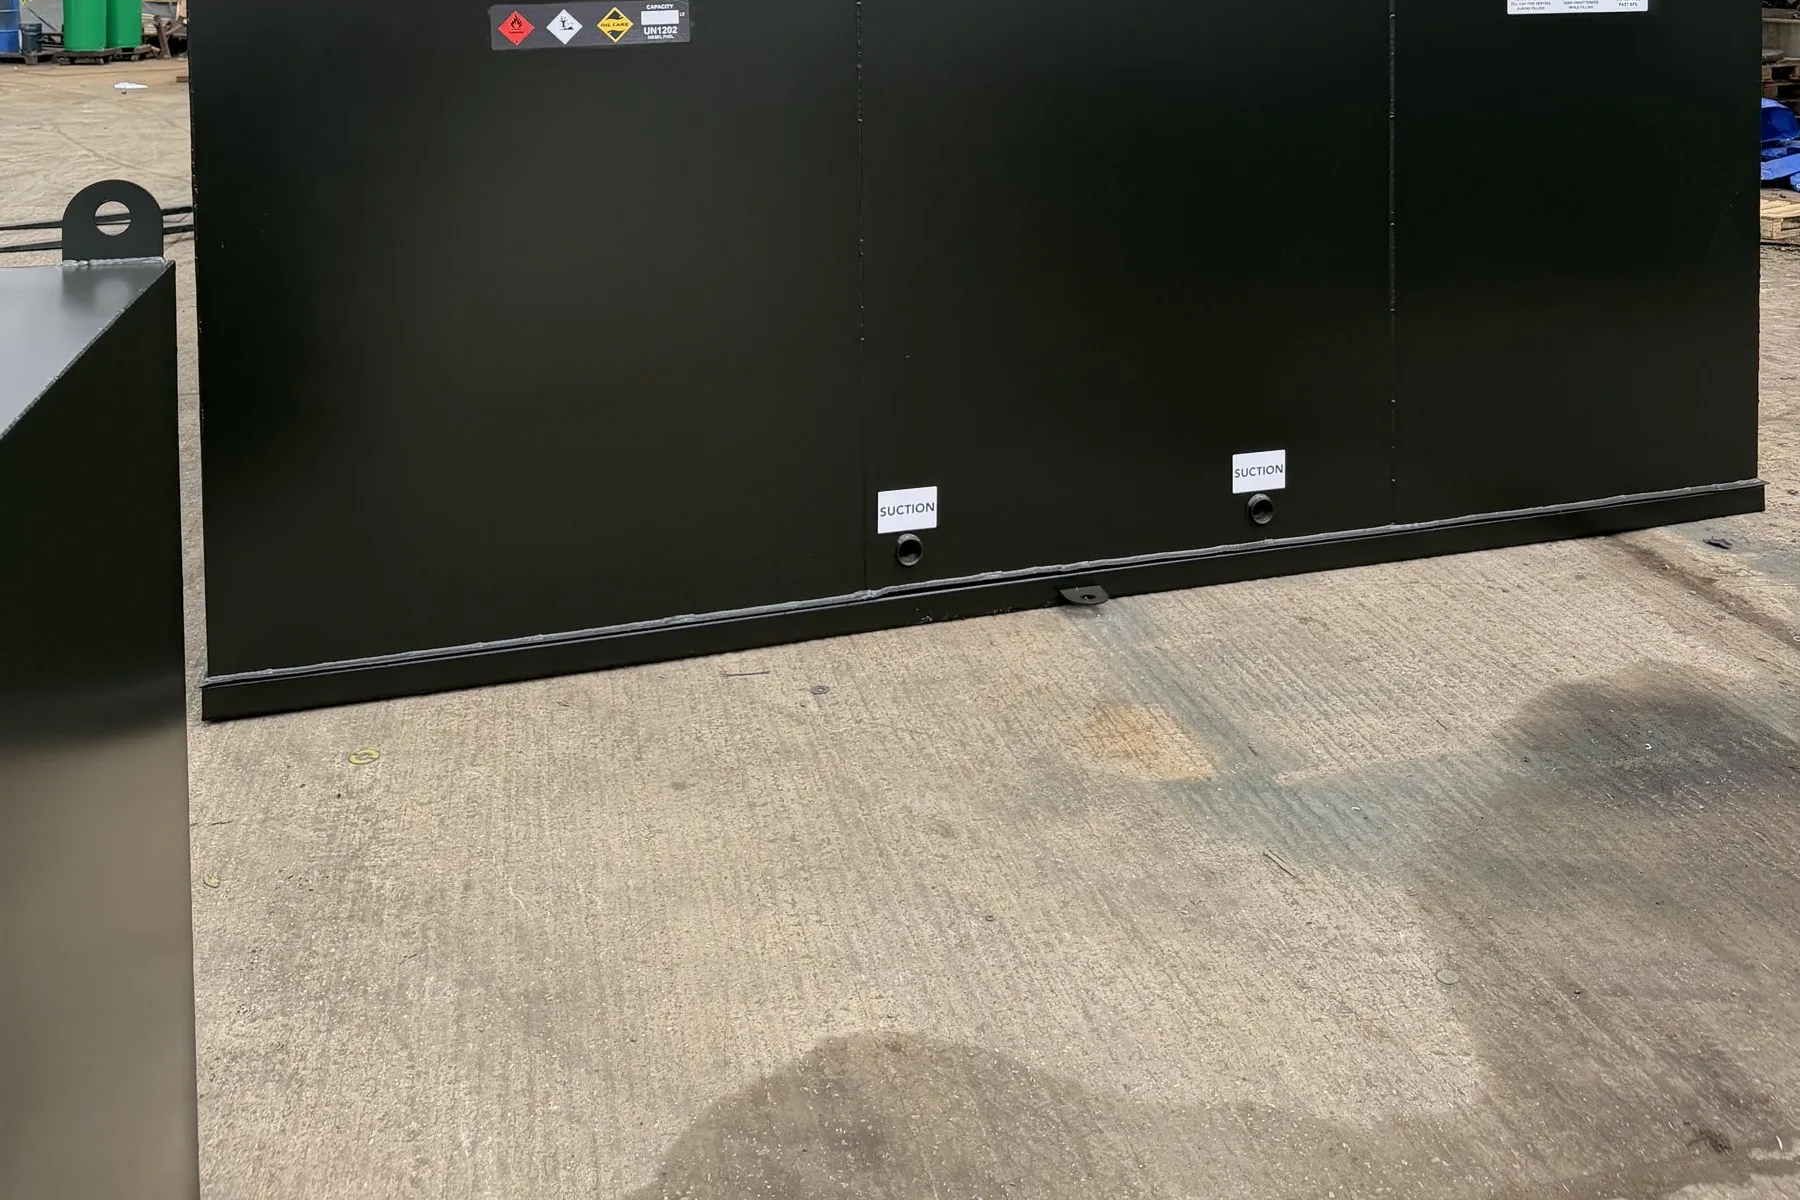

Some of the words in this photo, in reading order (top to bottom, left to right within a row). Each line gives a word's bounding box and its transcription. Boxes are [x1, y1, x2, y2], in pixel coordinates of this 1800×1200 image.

[643, 25, 678, 35] UN1202
[1234, 464, 1283, 478] SUCTION
[880, 502, 934, 517] SUCTION
